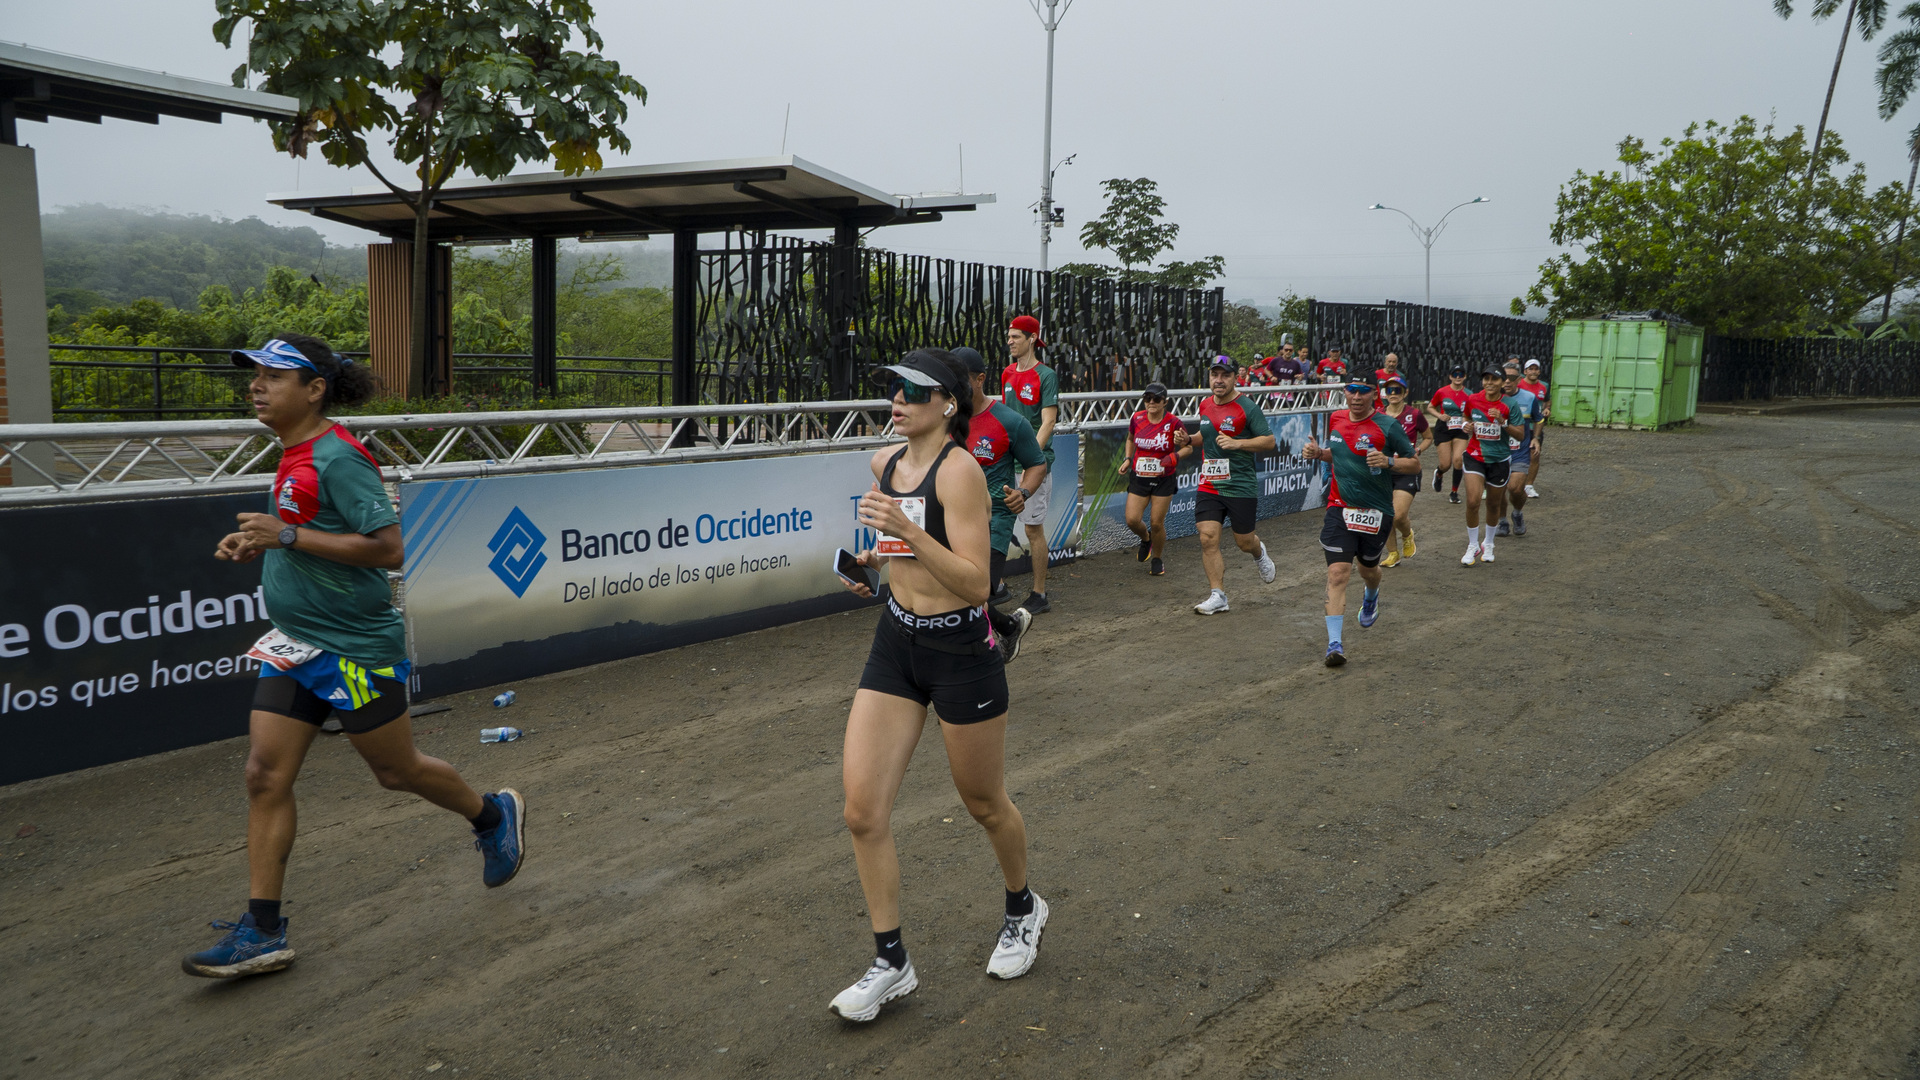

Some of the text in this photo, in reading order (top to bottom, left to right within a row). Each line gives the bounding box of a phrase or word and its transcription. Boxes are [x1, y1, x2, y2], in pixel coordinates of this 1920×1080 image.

[1478, 427, 1496, 435] 1843
[1143, 463, 1157, 472] 153
[1207, 466, 1221, 474] 474
[1264, 453, 1310, 474] TU HACER,
[1264, 472, 1310, 496] IMPACTA.
[1349, 513, 1375, 526] 1820
[561, 506, 813, 562] Banco de Occidente
[563, 553, 791, 603] Del lado de los que hacen.
[887, 596, 915, 627] NIKE
[916, 613, 961, 630] PRO
[1, 654, 261, 715] los que hacen.
